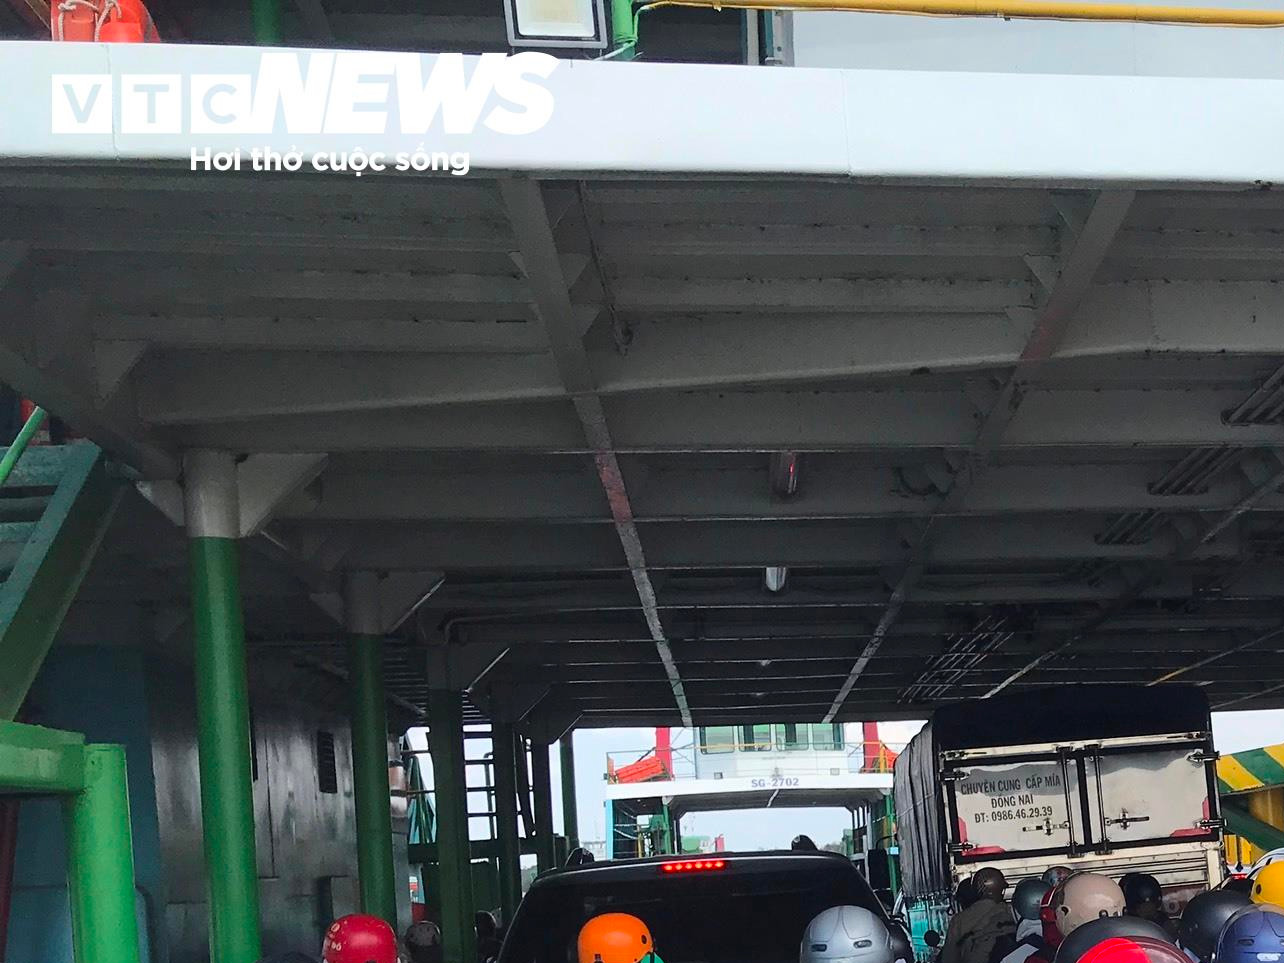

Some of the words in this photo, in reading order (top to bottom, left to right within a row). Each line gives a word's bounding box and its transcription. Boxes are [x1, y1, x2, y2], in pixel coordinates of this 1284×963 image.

[997, 778, 1021, 792] CUNG
[1018, 794, 1034, 805] NAI
[991, 806, 1053, 822] 0986.46.29.39
